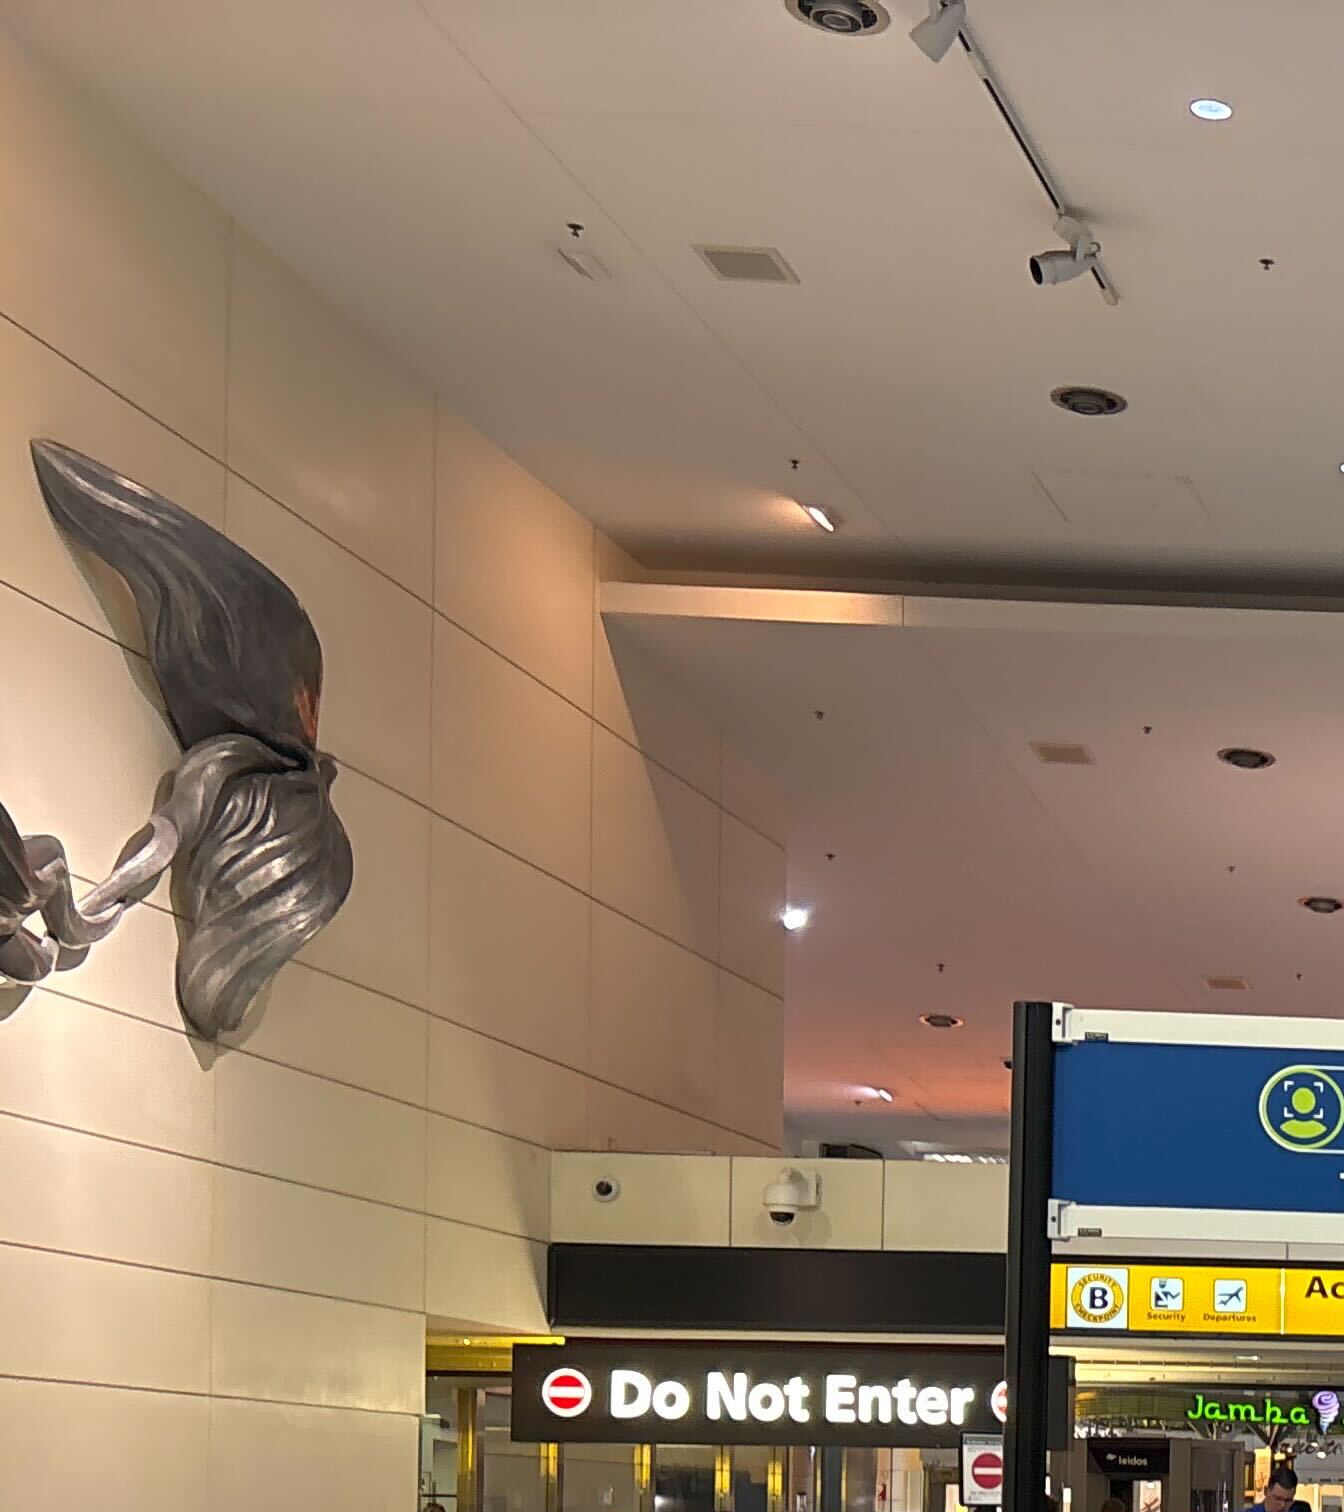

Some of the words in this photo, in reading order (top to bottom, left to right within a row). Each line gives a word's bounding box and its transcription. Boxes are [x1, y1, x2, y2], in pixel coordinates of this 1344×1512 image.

[1078, 1273, 1117, 1288] SECURITY
[1089, 1287, 1108, 1309] B
[1075, 1303, 1119, 1323] CHECKPOINT
[1147, 1312, 1186, 1322] Security
[1203, 1313, 1256, 1322] Departures
[609, 1369, 691, 1420] Do
[706, 1371, 810, 1422] Not
[825, 1373, 975, 1426] Enter
[1187, 1395, 1310, 1425] Jamba
[1118, 1455, 1148, 1467] leidos
